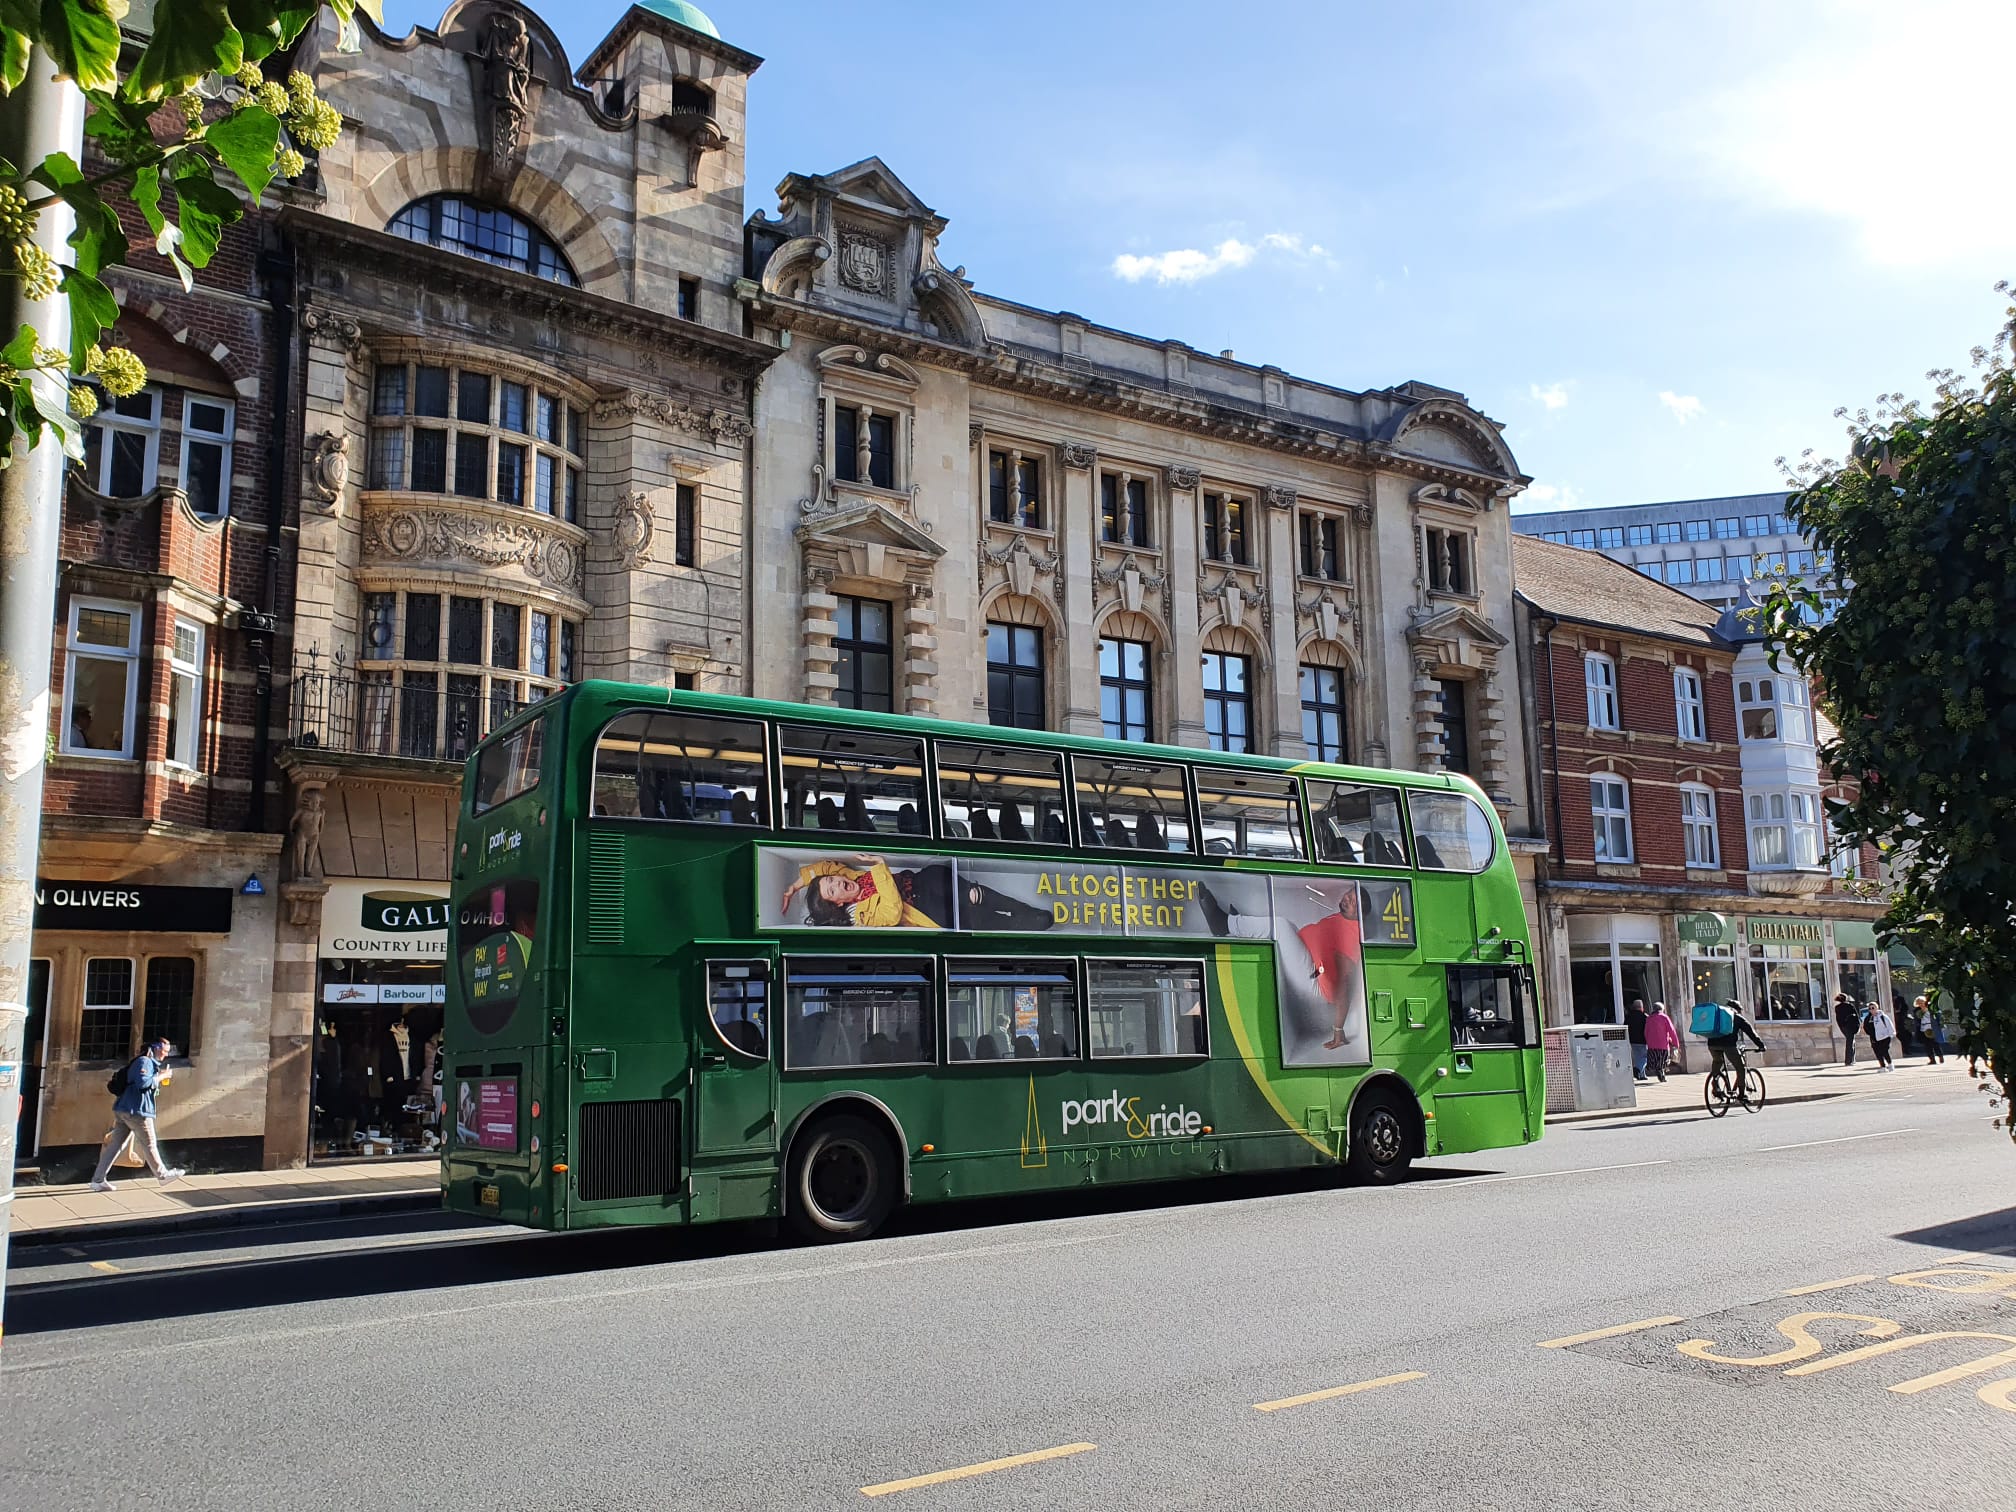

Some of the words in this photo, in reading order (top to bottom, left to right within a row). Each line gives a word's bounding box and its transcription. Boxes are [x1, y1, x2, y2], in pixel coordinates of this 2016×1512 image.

[53, 889, 141, 908] OLIVERS
[1382, 886, 1410, 939] 4
[1695, 920, 1718, 930] BELLA
[1695, 929, 1720, 938] ITALIA
[1753, 922, 1785, 939] BELLA
[1788, 924, 1822, 941] ITALIA
[333, 938, 411, 952] COUNTRY
[384, 989, 426, 999] Barbour
[1061, 1089, 1202, 1139] park&ride
[1063, 1140, 1202, 1165] NORWICH
